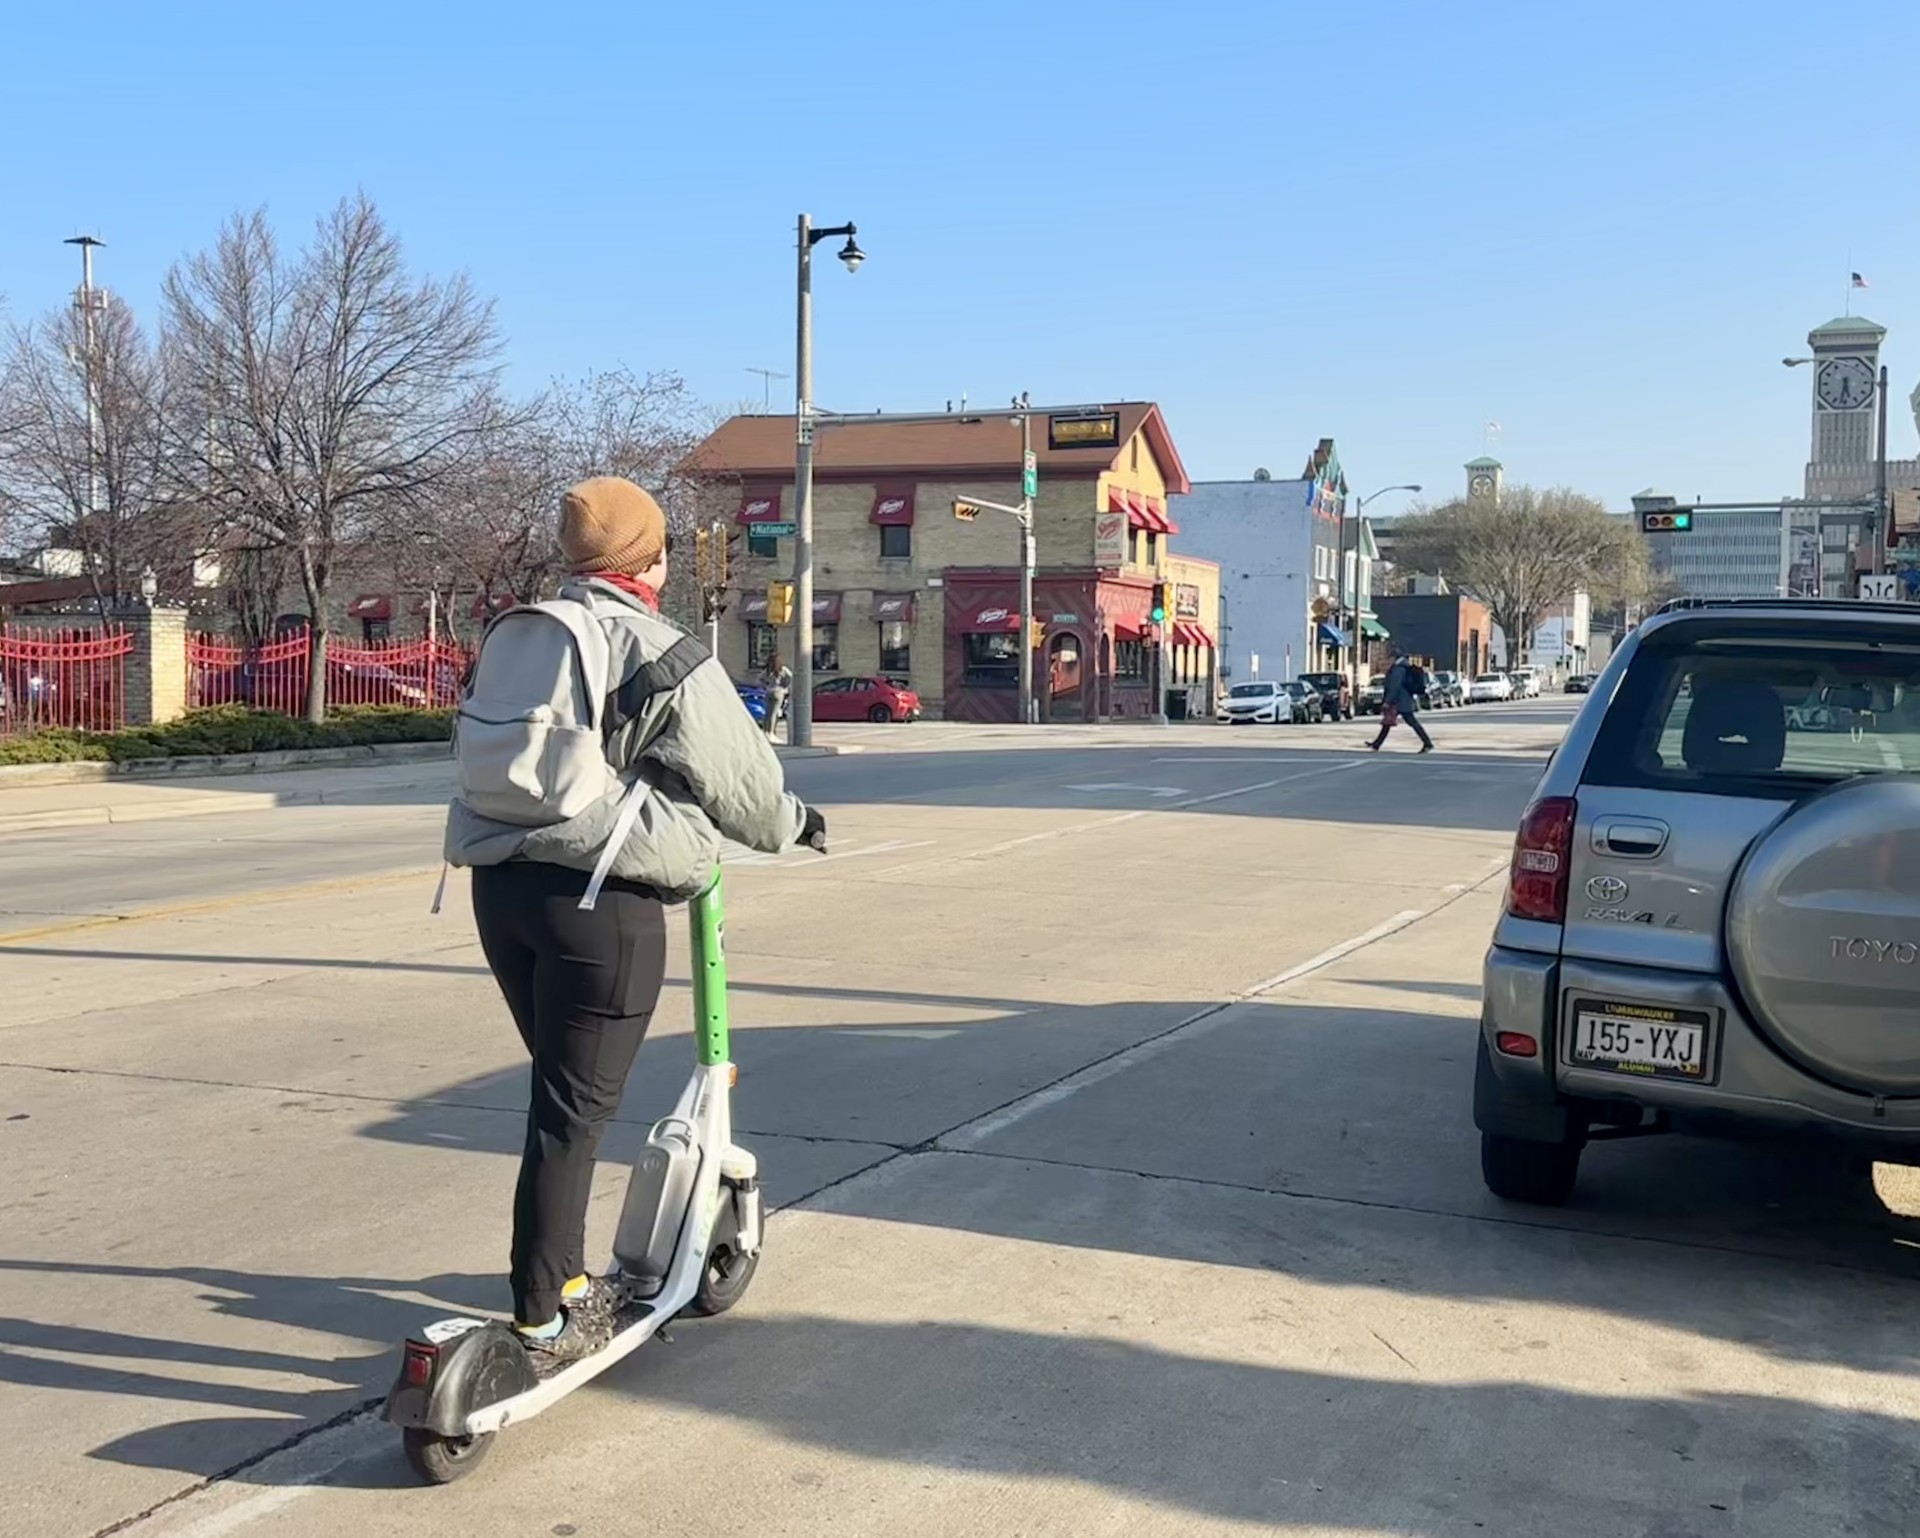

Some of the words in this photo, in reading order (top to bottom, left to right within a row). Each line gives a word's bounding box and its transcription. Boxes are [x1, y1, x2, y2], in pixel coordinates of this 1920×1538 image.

[755, 524, 789, 535] National
[1583, 907, 1654, 924] RAV4
[1664, 911, 1687, 929] L
[1586, 1020, 1694, 1062] 155-YXJ
[1617, 1062, 1655, 1074] ALUMNI
